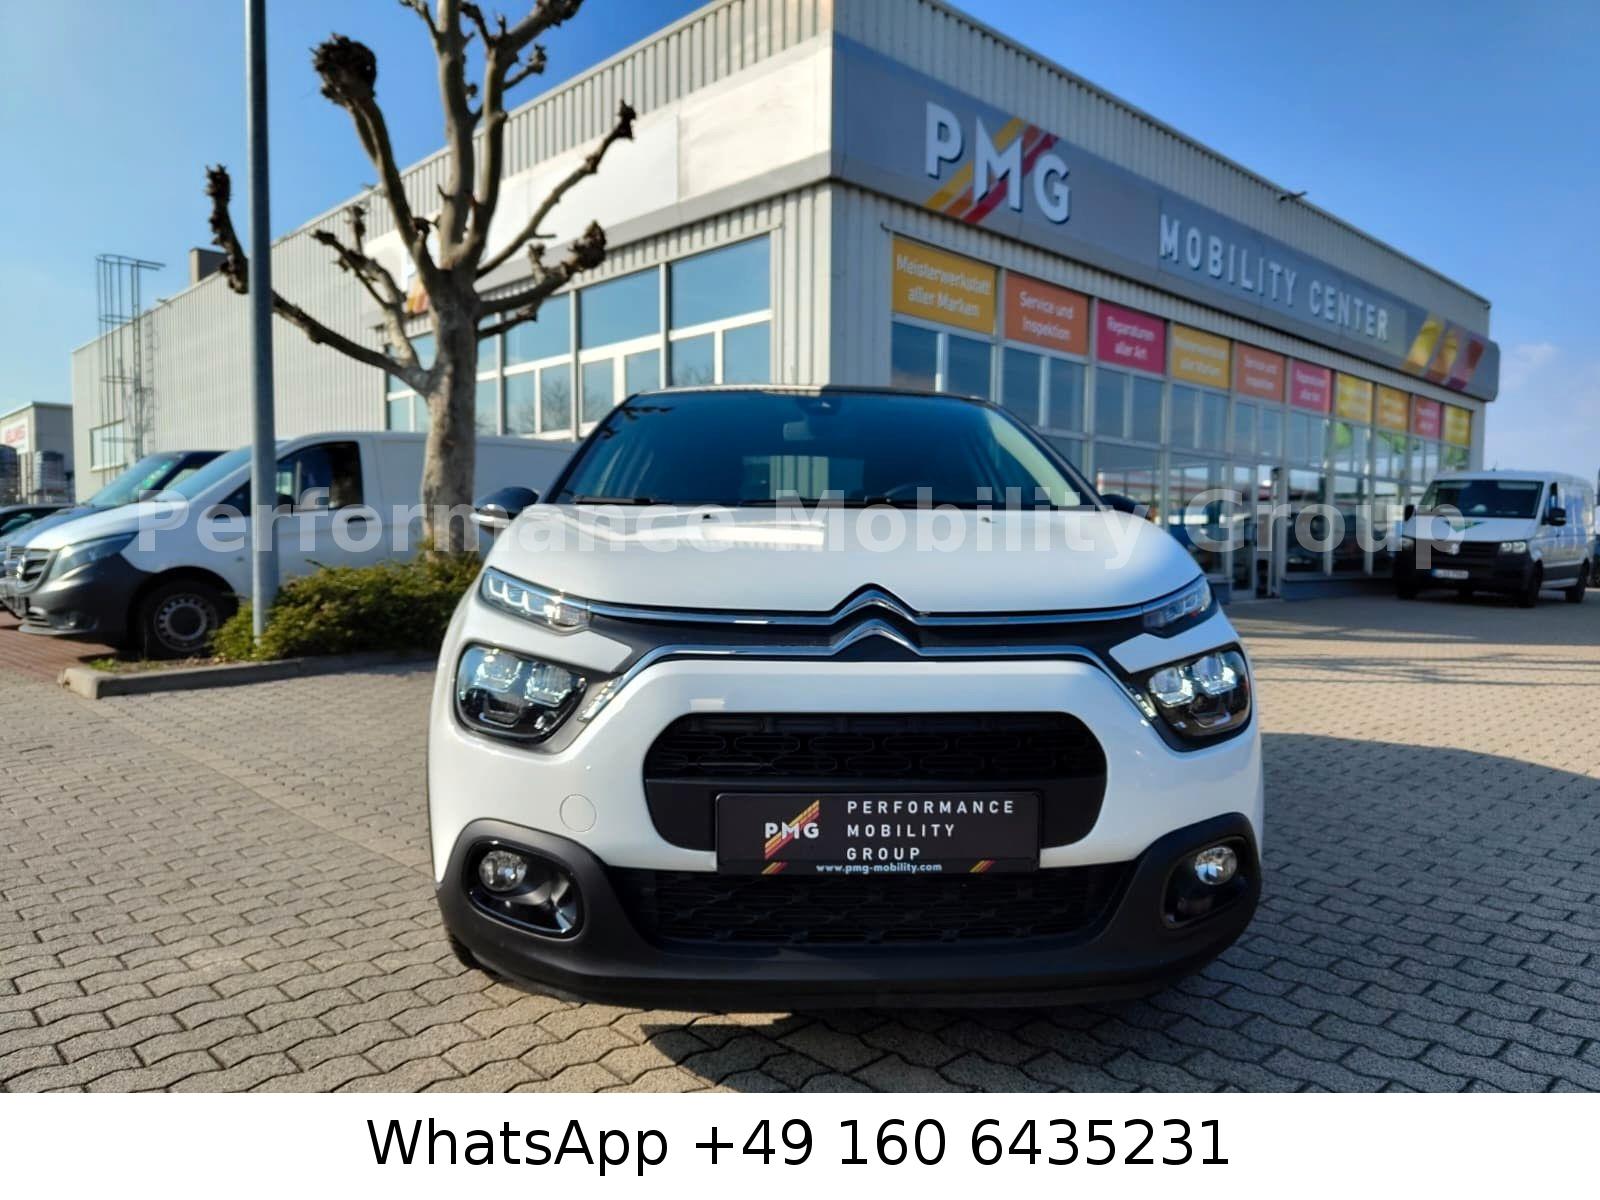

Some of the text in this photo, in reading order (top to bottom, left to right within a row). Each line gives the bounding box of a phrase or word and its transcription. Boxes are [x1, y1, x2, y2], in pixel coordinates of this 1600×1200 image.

[925, 101, 1071, 223] PMG
[896, 254, 991, 295] Meisterwerkstatt
[1159, 213, 1389, 343] MOBILITY CENTER
[908, 286, 980, 317] aller Marken
[1019, 291, 1074, 320] Service und
[1022, 316, 1071, 341] Inspektion
[847, 800, 1014, 815] PERFORMANCE
[764, 821, 820, 840] PMG
[847, 823, 955, 838] MOBILITY
[846, 846, 921, 861] GROUP
[815, 861, 943, 875] www.pmg-mobility.com
